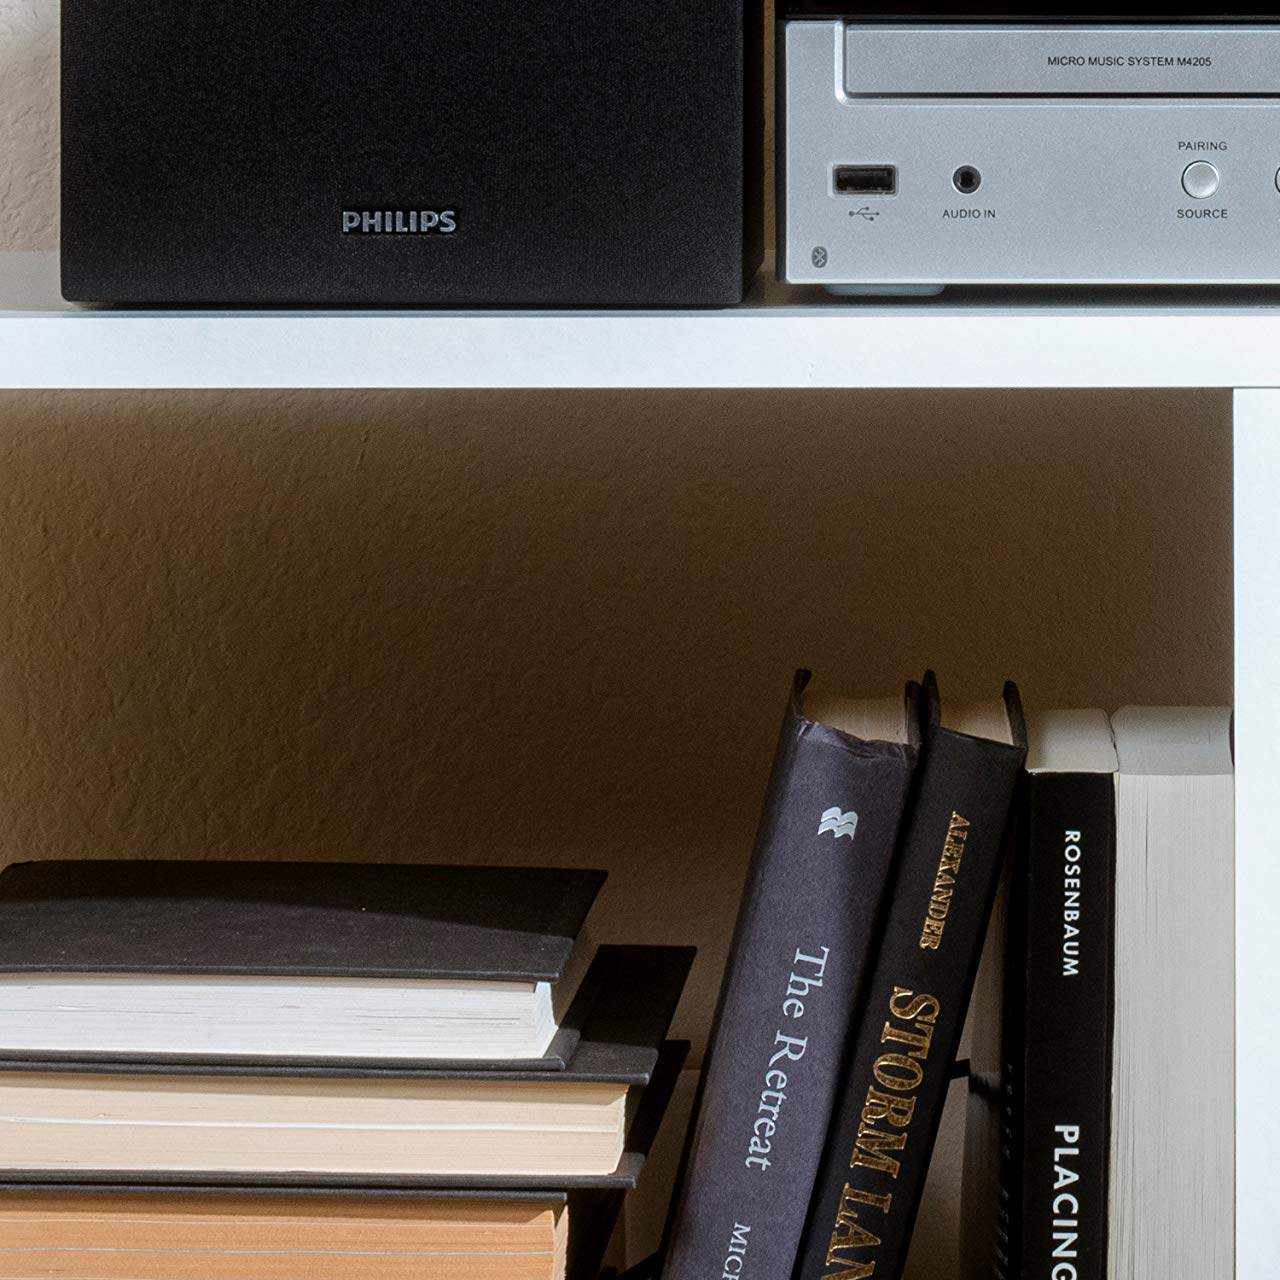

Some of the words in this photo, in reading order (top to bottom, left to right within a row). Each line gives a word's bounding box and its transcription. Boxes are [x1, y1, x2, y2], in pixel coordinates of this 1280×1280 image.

[1047, 55, 1086, 67] MICRO
[1088, 56, 1125, 67] MUSIC
[1127, 56, 1174, 67] SYSTEM
[1176, 56, 1212, 67] M4205
[1178, 141, 1228, 151] PAIRING
[342, 210, 457, 233] PHILIPS
[942, 208, 981, 219] AUDIO
[983, 209, 996, 219] IN
[1176, 208, 1228, 219] SOURCE
[919, 810, 971, 950] ALEXANDER
[1062, 830, 1081, 976] ROSENBAUM
[782, 945, 830, 1019] The
[744, 1029, 809, 1171] Retreat
[848, 985, 941, 1180] STORM
[1051, 1125, 1080, 1280] PLACING
